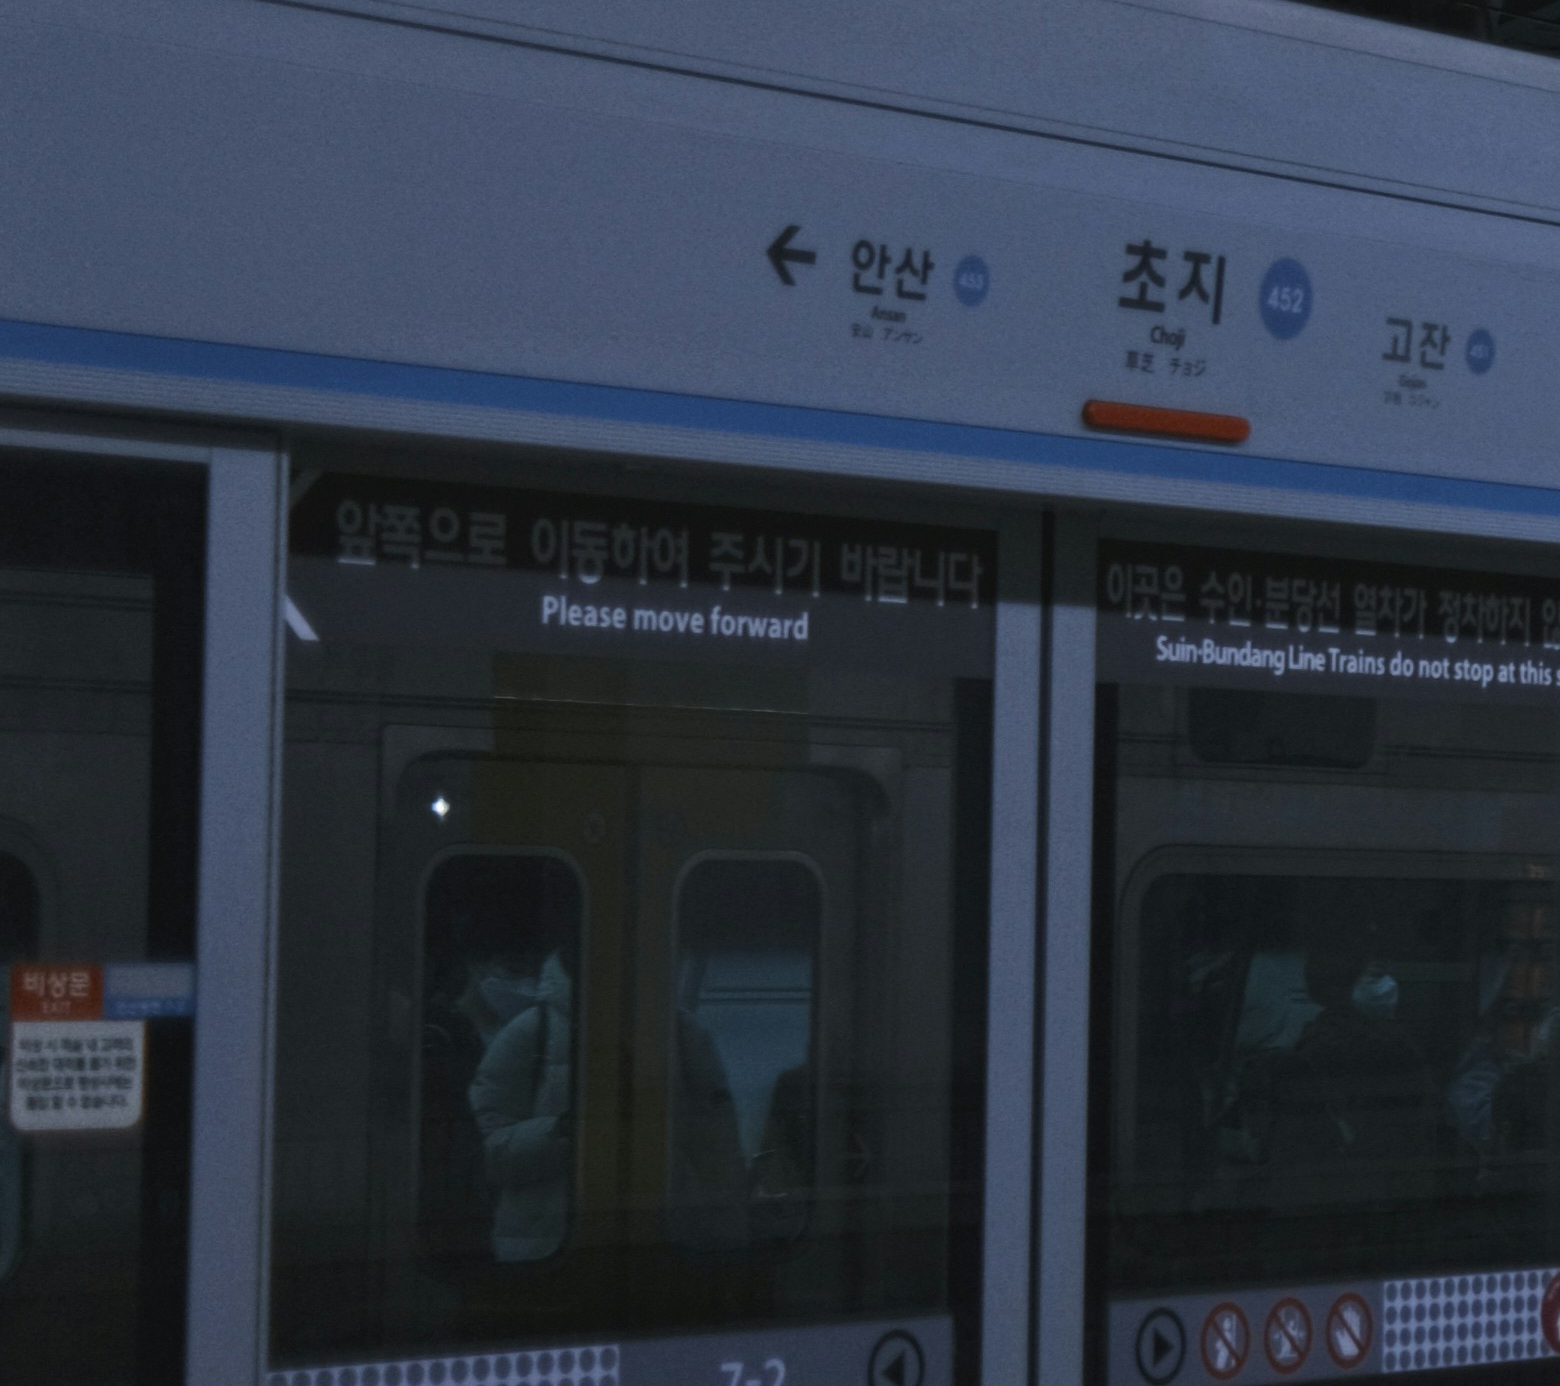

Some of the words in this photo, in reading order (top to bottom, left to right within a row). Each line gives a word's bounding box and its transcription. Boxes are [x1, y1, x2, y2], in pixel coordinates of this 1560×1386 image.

[852, 239, 935, 301] 안산
[1118, 240, 1225, 325] 초지
[1266, 286, 1304, 313] 452
[1151, 326, 1186, 350] Choji
[1382, 317, 1450, 370] 고잔
[336, 499, 507, 569] 앞쪽으로
[531, 517, 689, 589] 이동하여
[709, 531, 821, 598] 주시기
[841, 543, 984, 609] 바랍니다
[541, 595, 627, 629] Please
[633, 607, 704, 634] move
[710, 605, 809, 640] forward
[1107, 563, 1187, 622] 이곳은
[1354, 583, 1427, 641] 열차가
[1439, 589, 1532, 647] 정차하지
[1289, 644, 1325, 671] Line
[1328, 647, 1385, 676] Trains
[1390, 650, 1414, 677] do
[1419, 658, 1450, 679] not
[1454, 661, 1494, 688] stop
[1497, 663, 1516, 683] at
[1520, 659, 1553, 686] this
[22, 971, 92, 999] 비상문
